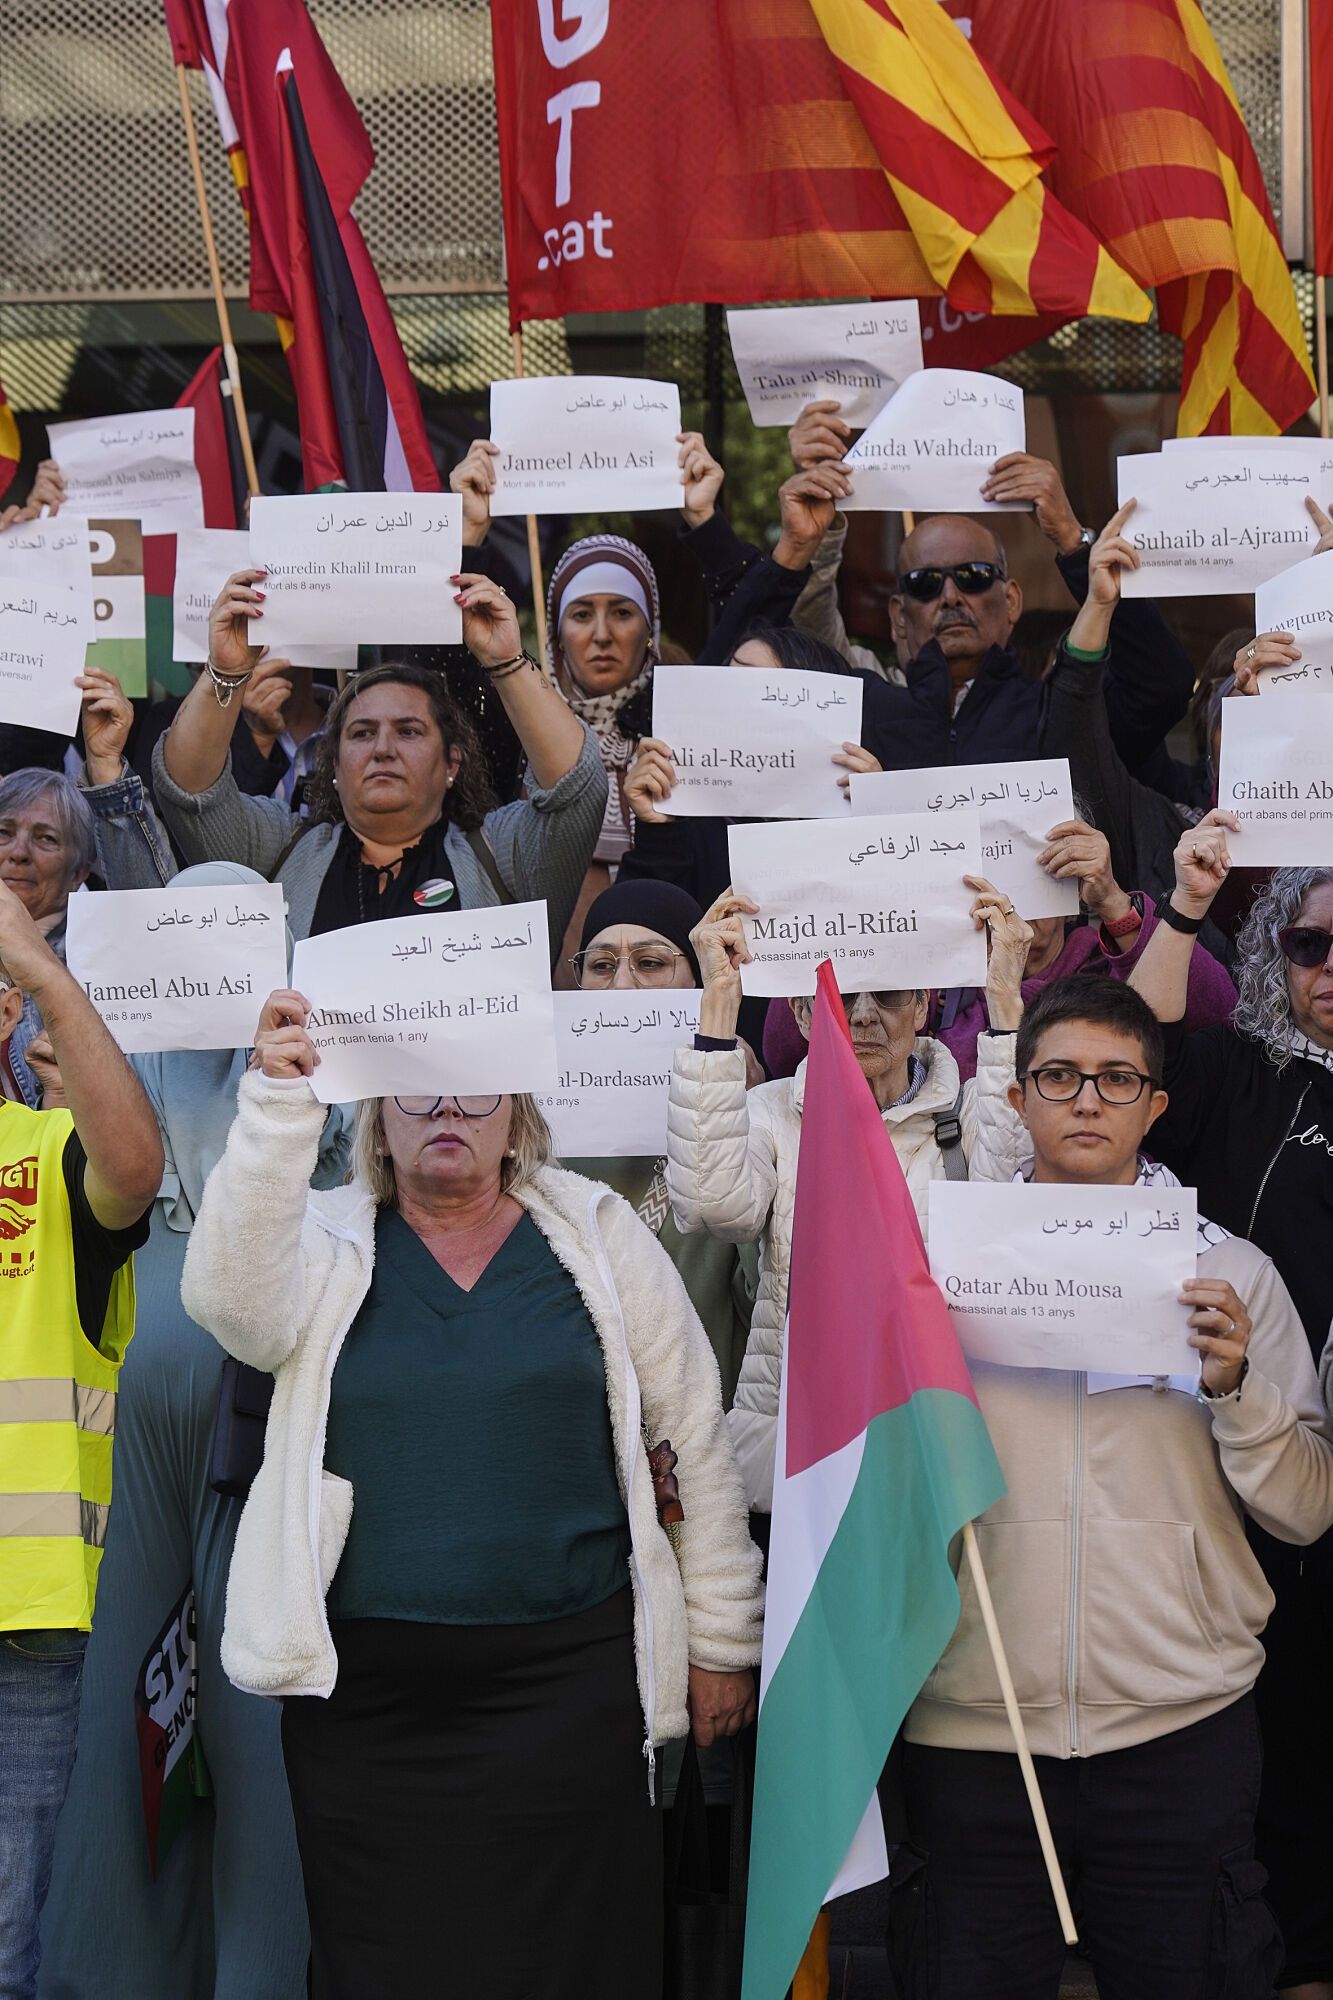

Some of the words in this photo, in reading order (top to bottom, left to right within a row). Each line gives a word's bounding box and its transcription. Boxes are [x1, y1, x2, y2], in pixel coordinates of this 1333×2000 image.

[753, 373, 796, 390] Tala
[801, 369, 882, 389] al-Shami
[633, 394, 669, 412] جميل
[914, 438, 998, 457] Wahdan
[502, 453, 572, 472] Jameel
[578, 451, 617, 470] Abu
[624, 450, 654, 468] Asi
[115, 473, 137, 487] Abu
[1258, 473, 1310, 486] صهيب
[316, 512, 367, 533] عمران
[375, 511, 413, 533] الدين
[423, 513, 449, 533] نور
[1133, 529, 1205, 551] Suhaib
[1211, 526, 1309, 550] al-Ajrami
[263, 561, 327, 575] Nouredin
[330, 561, 370, 575] Khalil
[375, 562, 417, 575] Imran
[1139, 558, 1182, 567] ssassinat
[1184, 558, 1197, 567] als
[1200, 557, 1210, 566] 14
[1213, 558, 1234, 567] anys
[263, 581, 283, 591] Mort
[284, 581, 299, 591] als
[301, 581, 307, 591] 8
[308, 582, 331, 592] anys
[816, 690, 847, 711] علي
[668, 748, 693, 768] Ali
[701, 748, 796, 773] al-Rayati
[674, 777, 686, 785] ort
[688, 777, 701, 785] als
[703, 777, 710, 785] 5
[712, 778, 733, 787] anys
[1016, 780, 1058, 803] ماريا
[1232, 780, 1299, 800] Ghaith
[1231, 809, 1252, 820] Mort
[1255, 810, 1287, 820] abans
[1290, 809, 1307, 819] del
[1309, 809, 1333, 821] prim
[849, 835, 920, 865] الرفاعي
[929, 839, 966, 856] مجد
[226, 904, 270, 926] جميل
[490, 921, 533, 950] أحمد
[751, 915, 818, 944] Majd
[825, 909, 918, 936] al-Rifai
[391, 936, 432, 962] العيد
[441, 933, 482, 962] شيخ
[753, 951, 811, 962] Assassinat
[814, 950, 830, 960] als
[834, 948, 846, 958] 13
[849, 948, 875, 958] anys
[84, 978, 158, 1001] Jameel
[164, 976, 210, 998] Abu
[216, 973, 253, 996] Asi
[105, 1012, 120, 1021] als
[121, 1011, 128, 1021] 8
[130, 1012, 153, 1022] anys
[306, 1005, 377, 1030] Ahmed
[382, 999, 452, 1023] Sheikh
[458, 995, 520, 1017] al-Eid
[310, 1035, 335, 1049] Mort
[338, 1034, 366, 1046] quan
[368, 1032, 395, 1043] tenia
[398, 1032, 403, 1042] 1
[407, 1032, 429, 1043] any
[558, 1070, 671, 1088] al-Dardasawi
[546, 1096, 553, 1106] 6
[556, 1097, 580, 1108] anys
[1102, 1211, 1128, 1236] ابو
[1137, 1210, 1180, 1237] قطر
[944, 1275, 1002, 1299] Qatar
[1007, 1276, 1049, 1296] Abu
[1055, 1278, 1123, 1299] Mousa
[947, 1303, 1007, 1316] Assassinat
[1010, 1304, 1027, 1316] als
[1031, 1306, 1045, 1317] 13
[1048, 1307, 1075, 1320] anys
